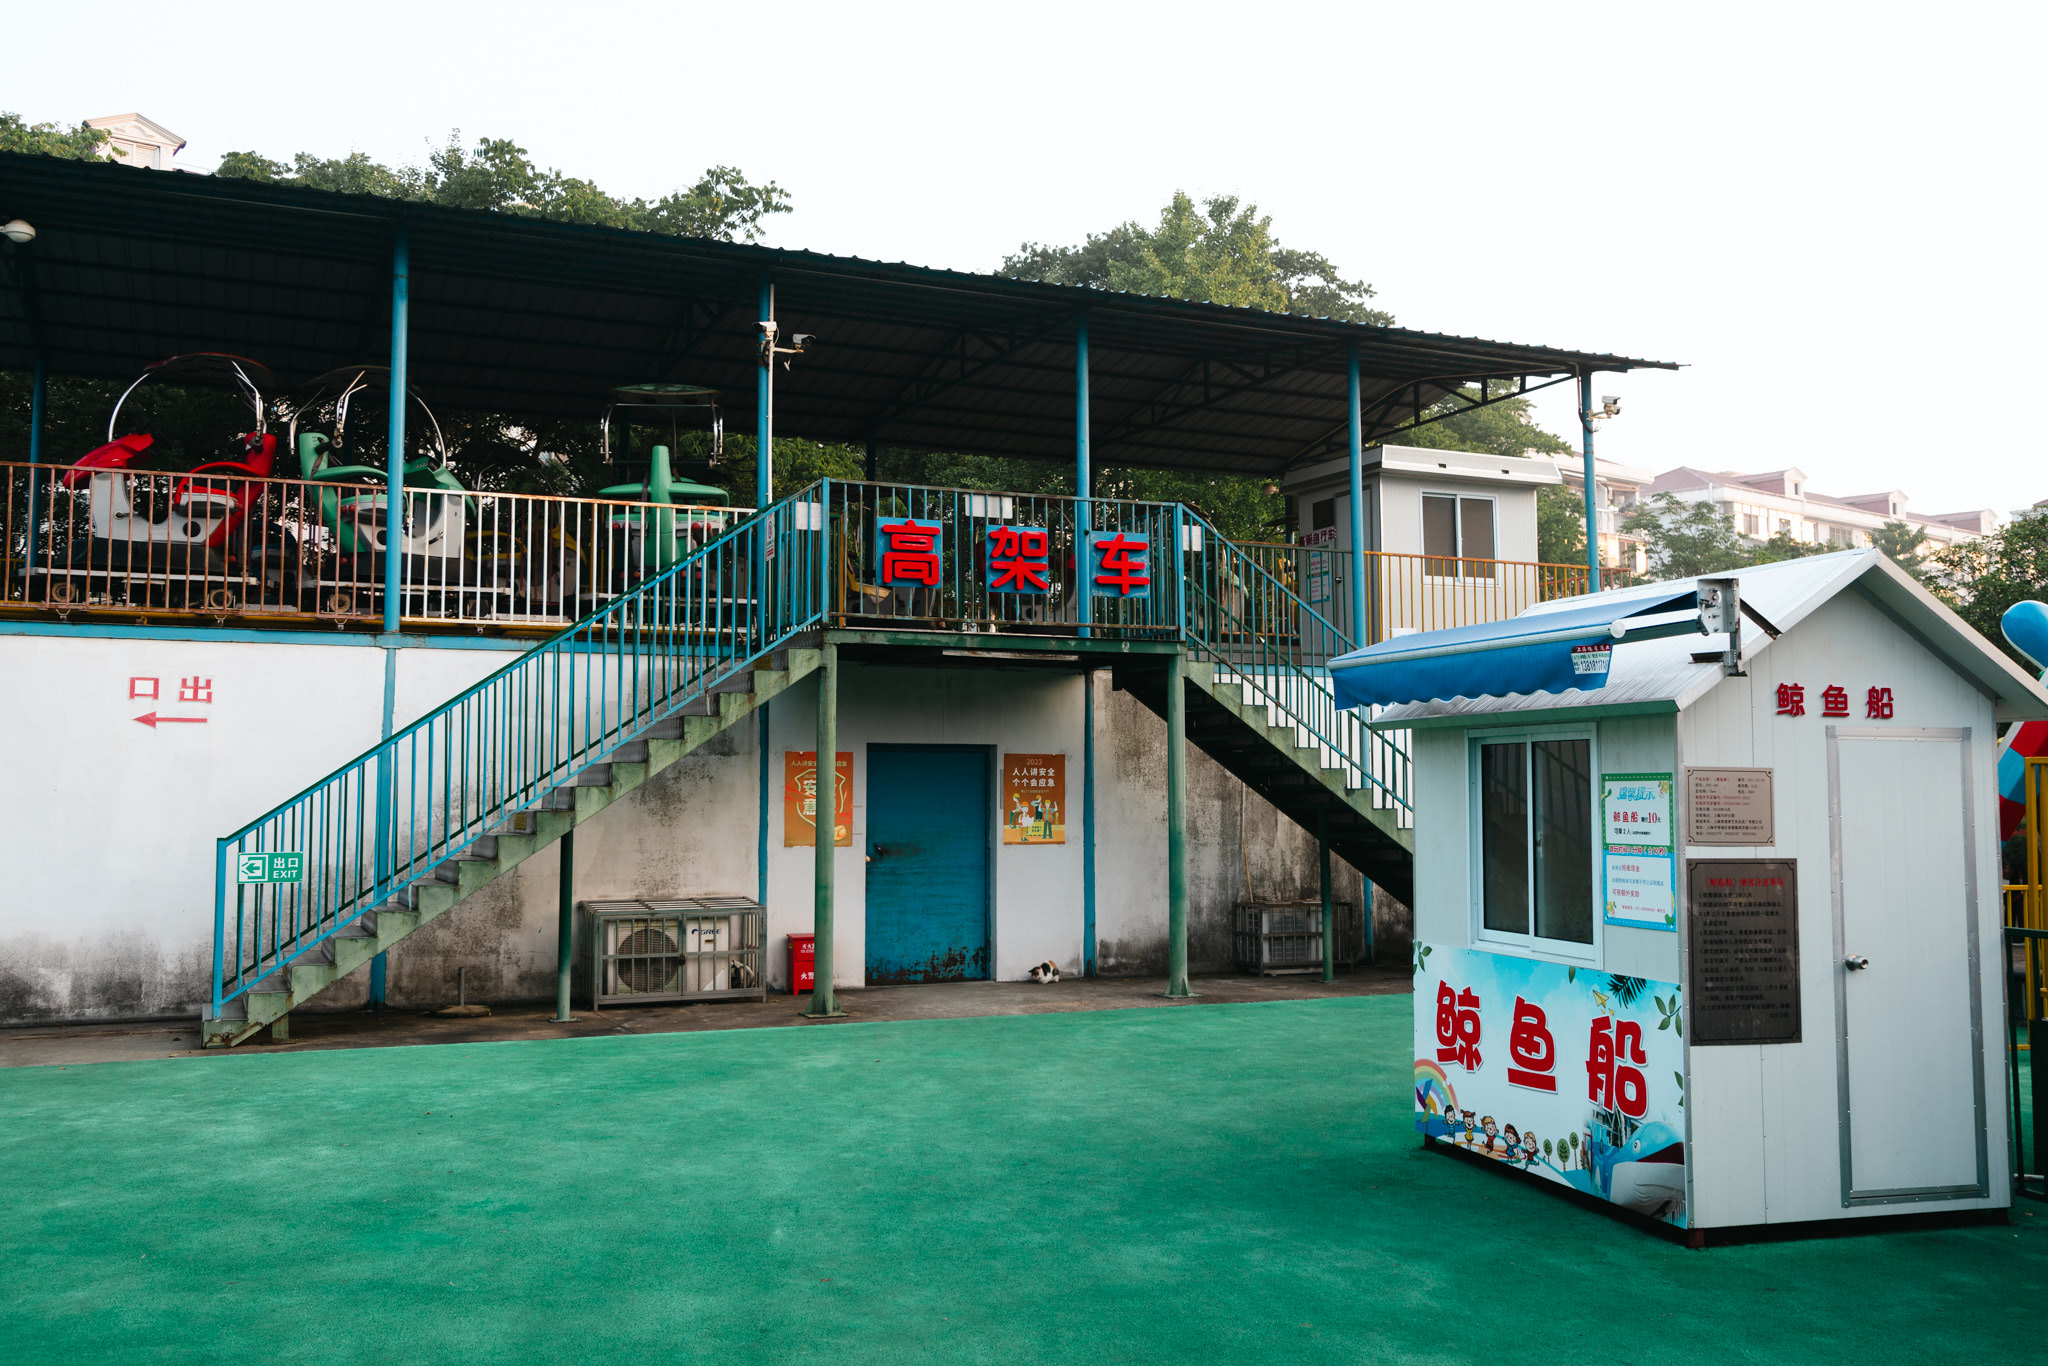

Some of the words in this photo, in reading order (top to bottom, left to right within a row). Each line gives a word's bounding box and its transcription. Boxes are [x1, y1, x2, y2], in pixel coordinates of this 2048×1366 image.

[881, 519, 1150, 595] 高架车
[1776, 682, 1894, 719] 鲸鱼船
[1026, 758, 1043, 766] 2023
[1012, 767, 1055, 777] 人人讲安全
[1012, 778, 1055, 787] 个个会应急
[1613, 811, 1639, 823] 鲸鱼船
[274, 857, 298, 868] 出口
[273, 870, 298, 879] EXIT
[1436, 979, 1649, 1118] 鲸鱼船
